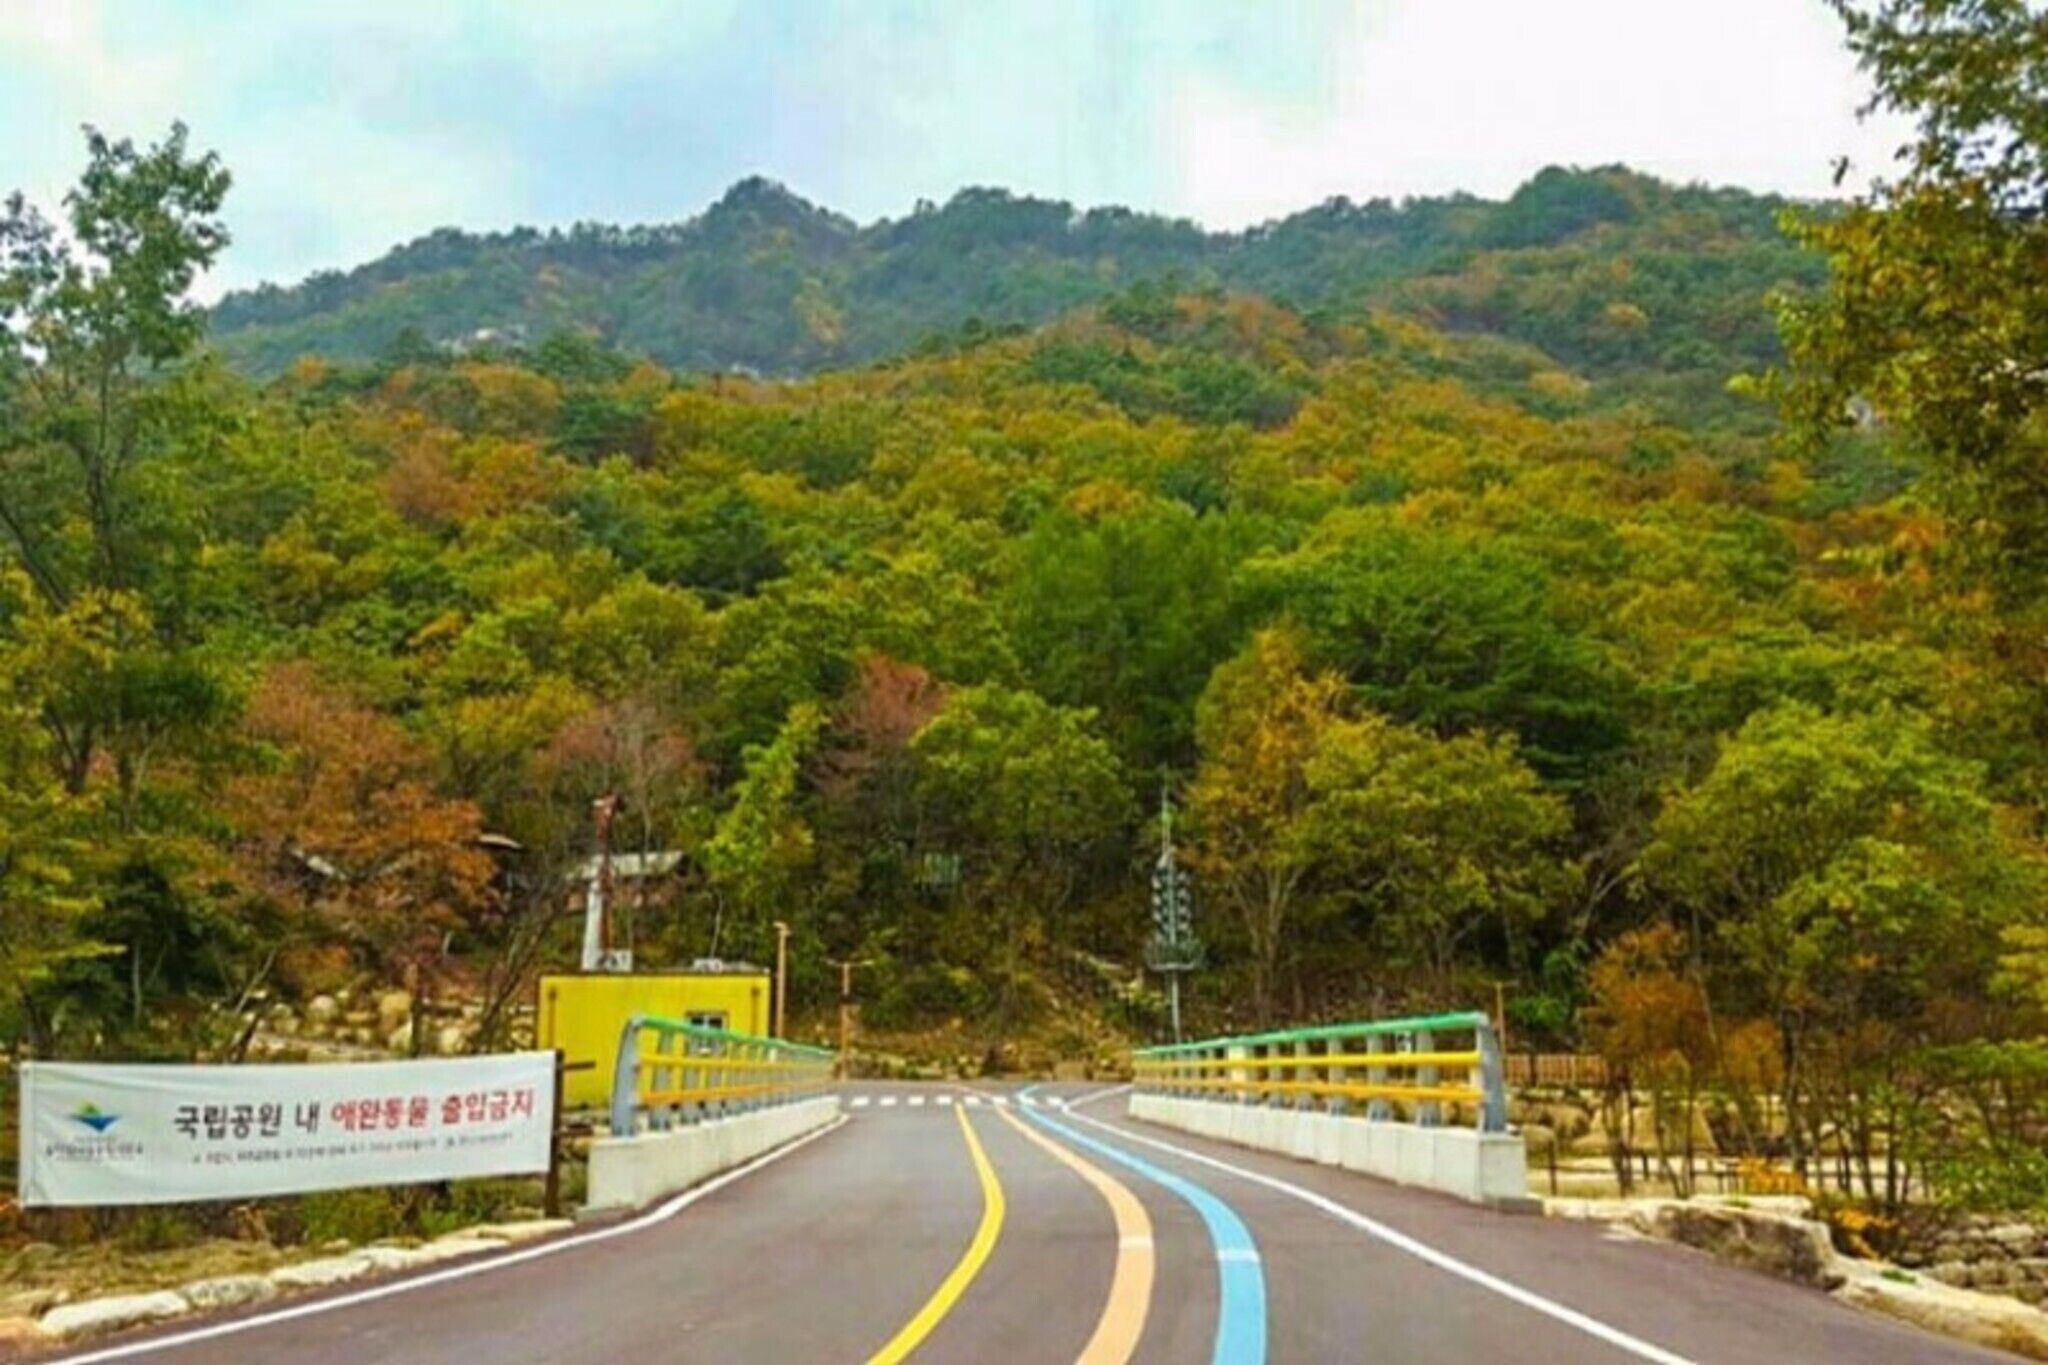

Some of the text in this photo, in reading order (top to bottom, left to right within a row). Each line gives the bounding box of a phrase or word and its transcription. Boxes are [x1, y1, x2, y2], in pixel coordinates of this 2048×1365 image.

[173, 1088, 534, 1140] 국립공원 내 애완동물 출입금지
